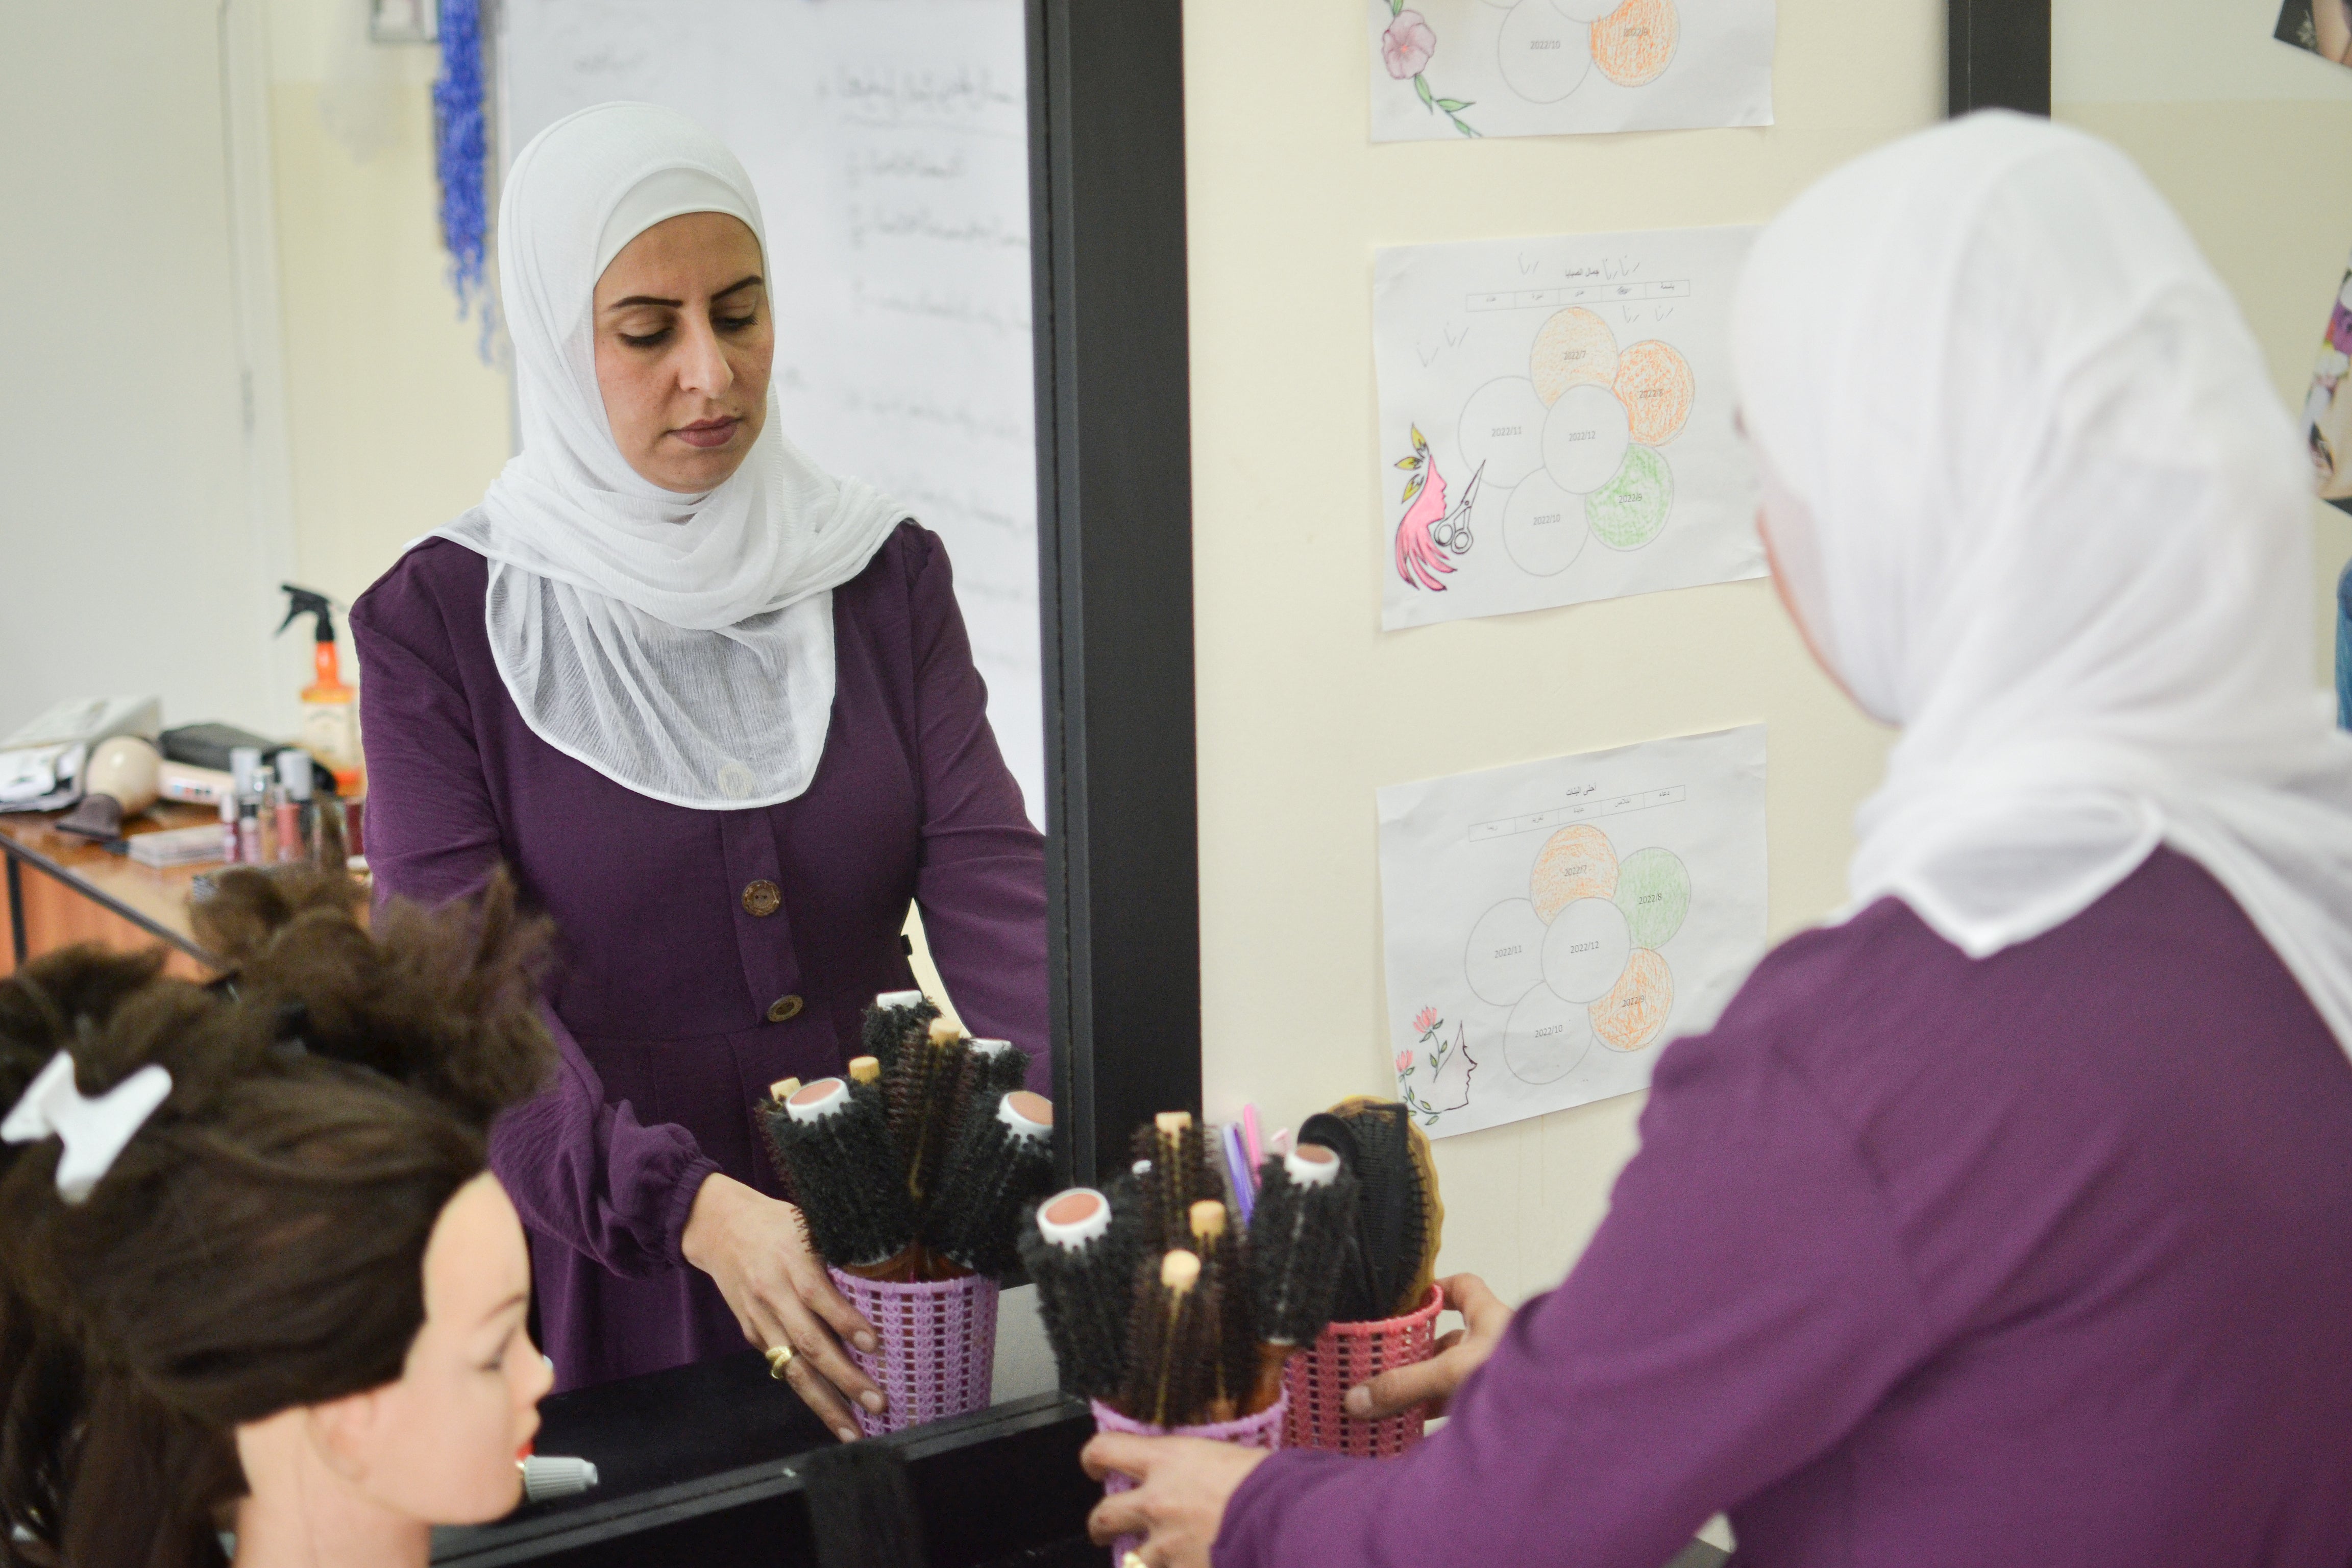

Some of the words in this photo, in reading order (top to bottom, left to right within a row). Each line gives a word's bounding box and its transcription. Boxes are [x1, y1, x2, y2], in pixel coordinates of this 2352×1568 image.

[1530, 40, 1560, 50] 2022/10
[1563, 350, 1586, 361] 2022/7
[1638, 388, 1664, 399] 2022/8
[1491, 427, 1522, 437] 2022/11
[1569, 431, 1596, 442] 2022/12
[1619, 493, 1643, 504] 2022/9
[1533, 514, 1560, 525] 2022/10
[1565, 786, 1582, 797] البنات
[1564, 865, 1587, 877] 2022/7
[1638, 893, 1662, 904] 2022/8
[1494, 945, 1523, 959] 2022/11
[1570, 941, 1600, 954] 2022/12
[1622, 995, 1645, 1008] 2022/9
[1534, 1024, 1563, 1038] 2022/10
